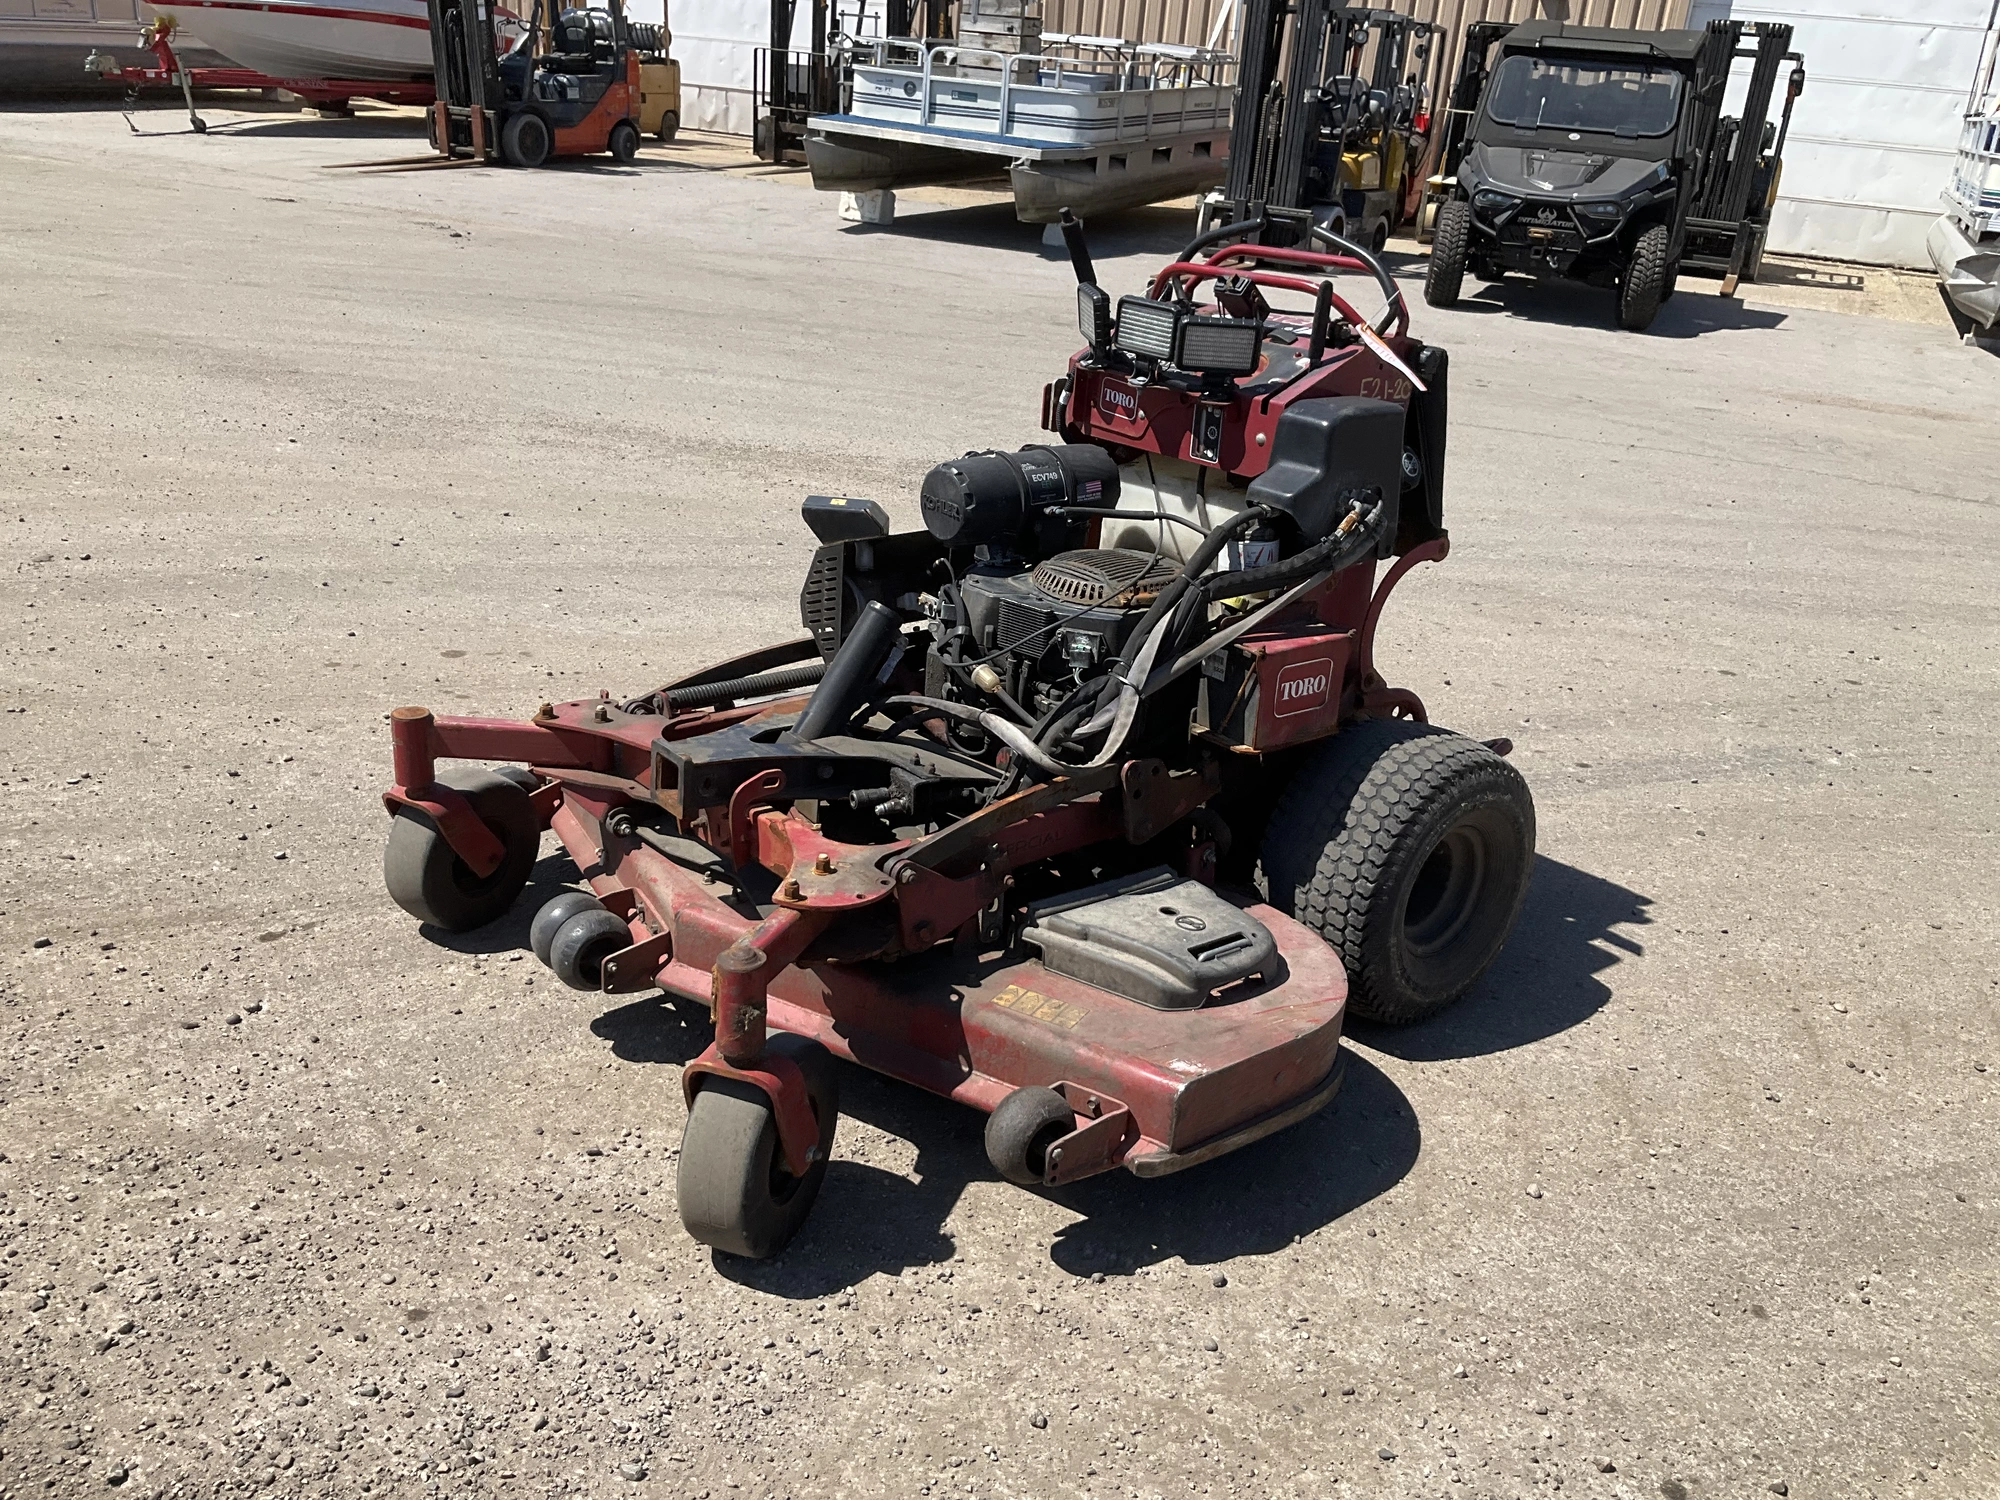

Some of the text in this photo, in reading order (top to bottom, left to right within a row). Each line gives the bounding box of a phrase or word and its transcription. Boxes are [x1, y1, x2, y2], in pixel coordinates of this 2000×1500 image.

[1517, 216, 1575, 229] INTIMIDATOR
[1104, 387, 1135, 409] TORO
[1031, 471, 1058, 482] ECV749
[1280, 674, 1326, 701] TORO
